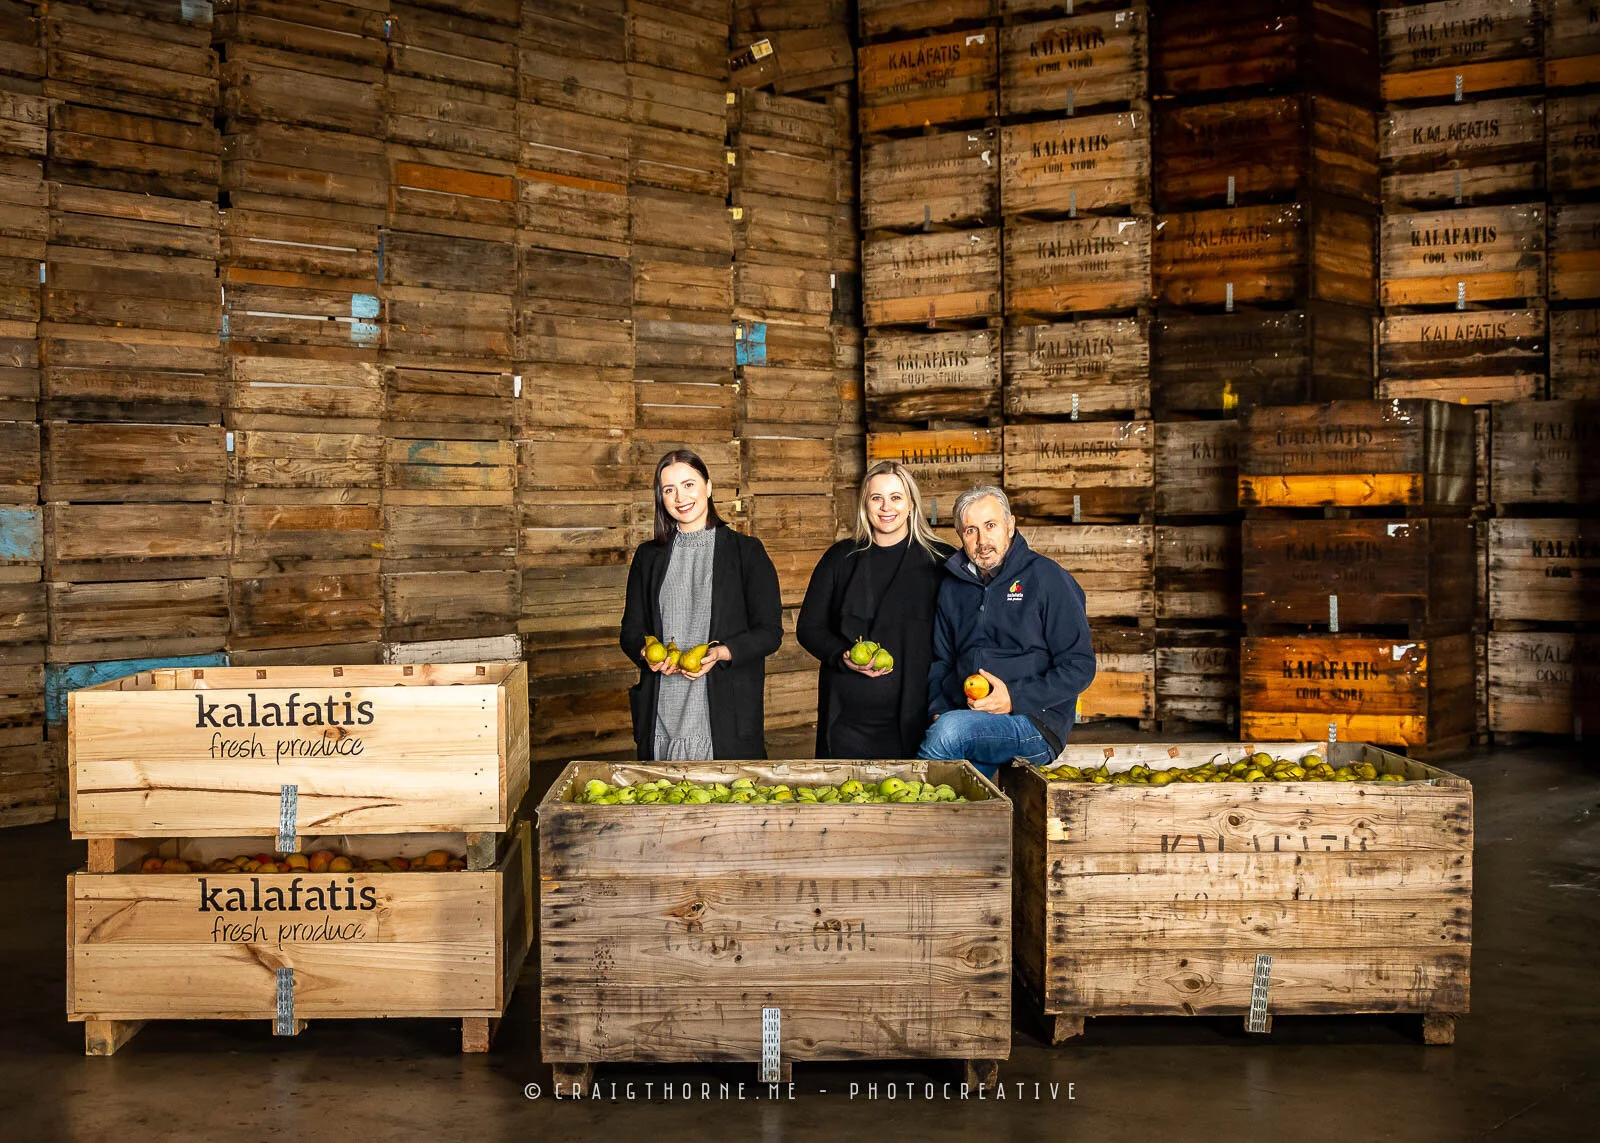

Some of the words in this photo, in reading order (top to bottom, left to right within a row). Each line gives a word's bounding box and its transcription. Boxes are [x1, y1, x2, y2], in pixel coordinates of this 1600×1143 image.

[887, 44, 961, 71] KALAFATIS
[1412, 119, 1499, 144] KALAFATIS
[1032, 134, 1109, 159] KALAFATIS
[1070, 158, 1097, 172] STORE
[1187, 223, 1271, 248] KALAFATIS
[1411, 225, 1497, 247] KALAFATIS
[1038, 237, 1115, 259] KALAFATIS
[1423, 252, 1447, 264] COOL
[1453, 250, 1484, 263] STORE
[1421, 323, 1507, 342] KALAFATIS
[1038, 338, 1115, 359] KALAFATIS
[897, 350, 969, 371] KALAFATIS
[901, 372, 927, 385] COOL
[932, 371, 965, 384] STORE
[1276, 423, 1374, 447] KALAFATIS
[1040, 440, 1119, 459] KALAFATIS
[1282, 659, 1379, 681] KALAFATIS
[195, 691, 375, 728] kalafatis
[208, 731, 266, 759] fresh
[276, 729, 365, 766] produce
[198, 876, 377, 912] kalafatis
[211, 915, 269, 943] fresh
[278, 914, 367, 952] produce
